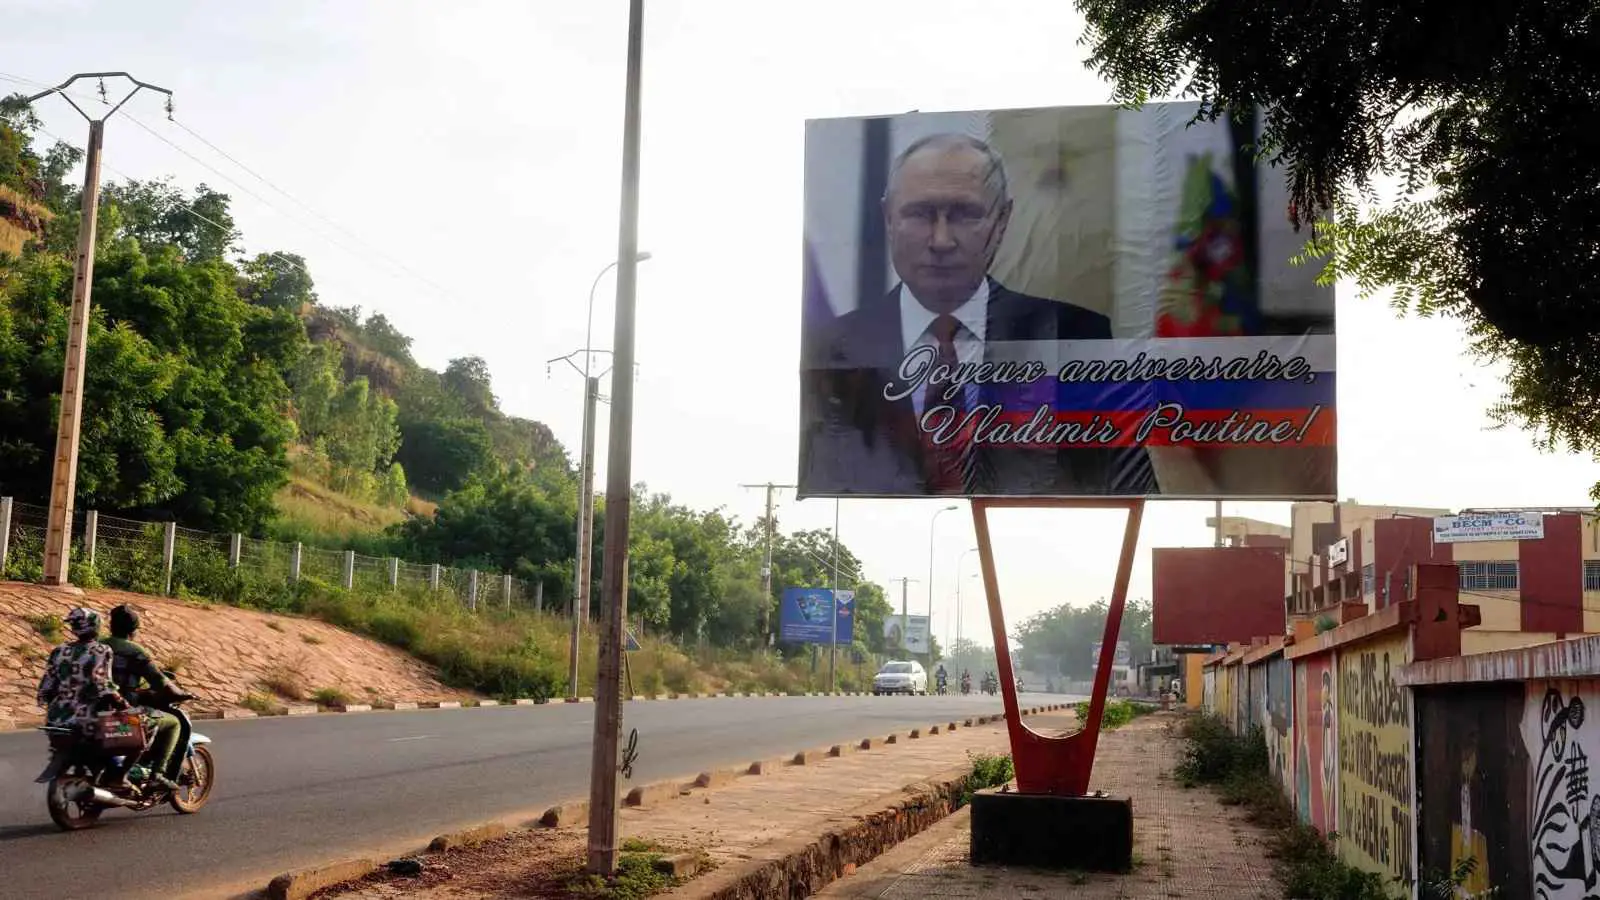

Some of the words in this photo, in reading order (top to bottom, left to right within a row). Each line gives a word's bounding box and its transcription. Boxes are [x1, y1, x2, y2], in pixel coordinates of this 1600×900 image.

[883, 344, 1046, 401] Joyeux
[1059, 350, 1316, 385] anniversaire,
[917, 404, 1121, 447] Vladimir
[1136, 402, 1320, 445] Poutine!
[1452, 519, 1492, 528] BECM
[1505, 517, 1525, 526] CG
